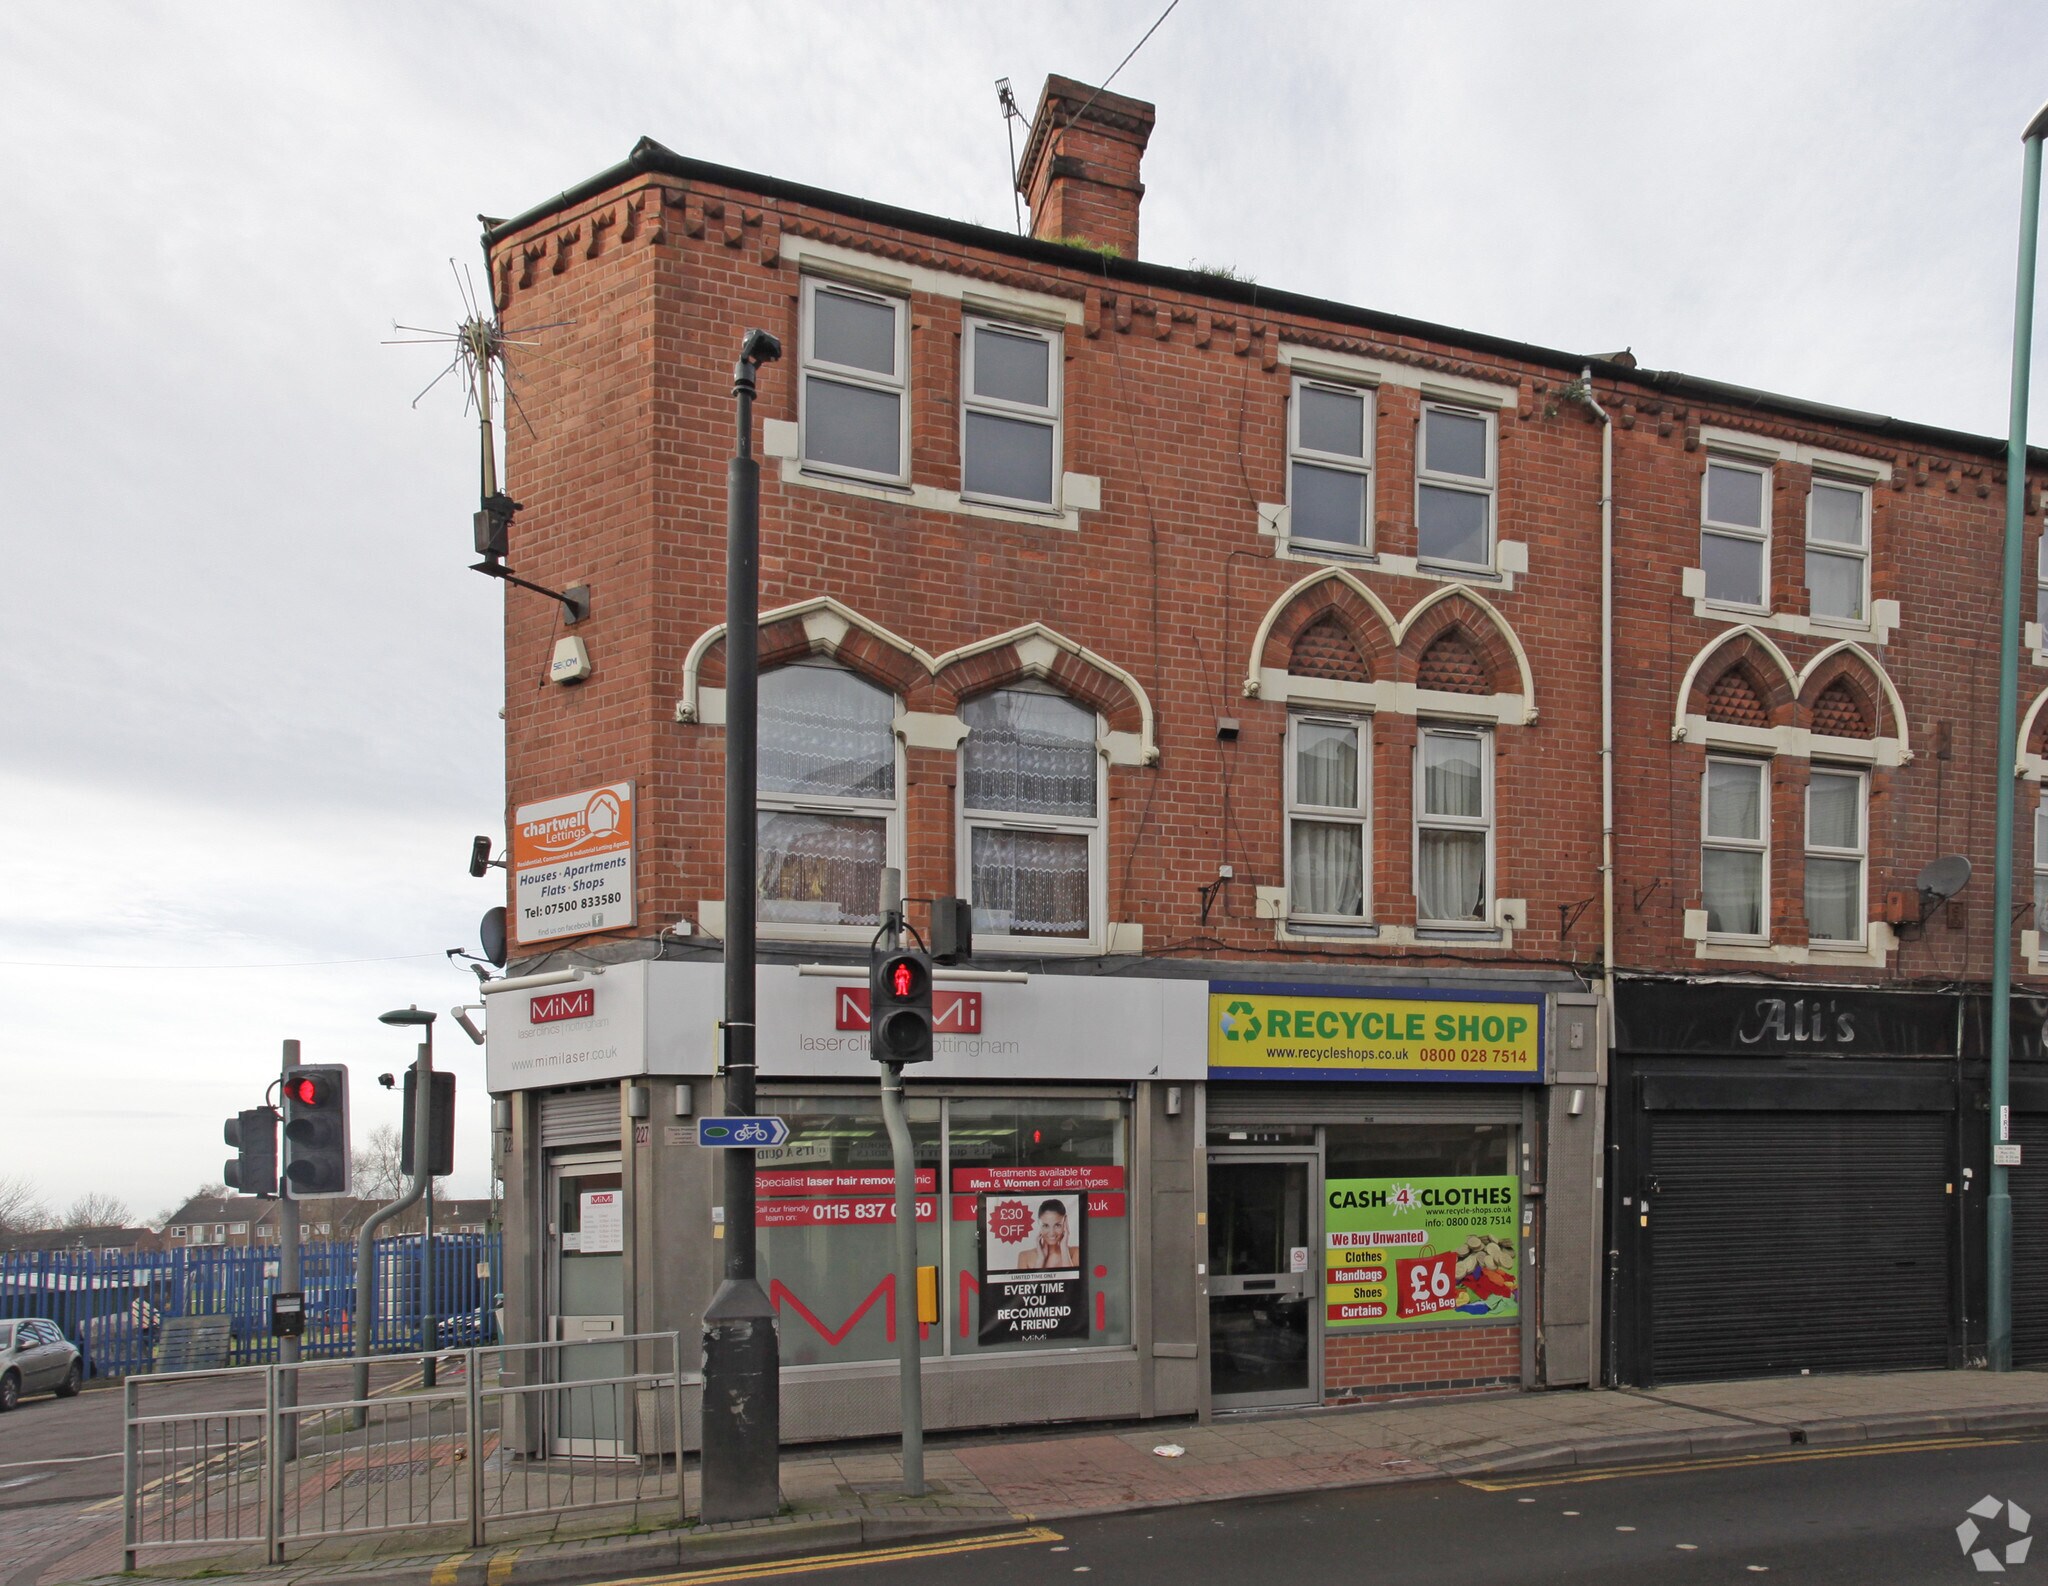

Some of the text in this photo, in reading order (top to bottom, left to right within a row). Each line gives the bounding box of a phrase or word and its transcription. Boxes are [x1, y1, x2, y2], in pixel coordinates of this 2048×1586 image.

[523, 810, 585, 838] chartwell
[546, 825, 586, 844] Lettings
[613, 840, 629, 849] Agents
[520, 857, 626, 886] Houses Apartments
[541, 878, 605, 898] Flats Shops
[525, 892, 621, 919] Tel: 07500 833580
[538, 928, 549, 936] find
[566, 922, 591, 932] facebook
[532, 993, 588, 1019] MiMi
[518, 1028, 536, 1039] laser
[565, 1018, 609, 1032] nottingham
[1267, 1009, 1528, 1043] RECYCLE SHOP
[1739, 999, 1855, 1044] Ali's
[800, 1034, 845, 1051] laser
[933, 1036, 1019, 1057] ottingham
[511, 1045, 618, 1071] www.mimilaser.co.uk
[1266, 1046, 1527, 1064] www.recycleshops.co.uk 0800 028 7514
[636, 1126, 648, 1143] 227
[988, 1167, 1091, 1178] Treatments available for
[756, 1177, 804, 1189] Specialist
[807, 1176, 834, 1186] laser
[837, 1176, 857, 1186] hair
[970, 1178, 1108, 1189] Men & Women of all skin types
[1329, 1187, 1511, 1209] CASH 4 CLOTHES
[783, 1205, 809, 1213] friendly
[813, 1204, 850, 1220] 0115
[855, 1203, 886, 1218] 837
[1000, 1208, 1023, 1220] £30
[1426, 1206, 1511, 1216] www.recycle-shops.co.uk
[1425, 1216, 1511, 1227] info: 0800 028 7514
[999, 1225, 1025, 1236] OFF
[1332, 1230, 1424, 1247] We Buy Unwanted
[1345, 1251, 1382, 1263] Clothes
[1335, 1268, 1382, 1282] Handbags
[1410, 1261, 1450, 1301] £6
[1004, 1282, 1064, 1296] EVERY TIME
[1353, 1287, 1382, 1298] Shoes
[1022, 1295, 1046, 1307] YOU
[1416, 1301, 1437, 1312] 15kg
[1438, 1297, 1456, 1308] Bag
[997, 1306, 1071, 1320] RECOMMEND
[1341, 1304, 1382, 1318] Curtains
[1009, 1320, 1019, 1331] A
